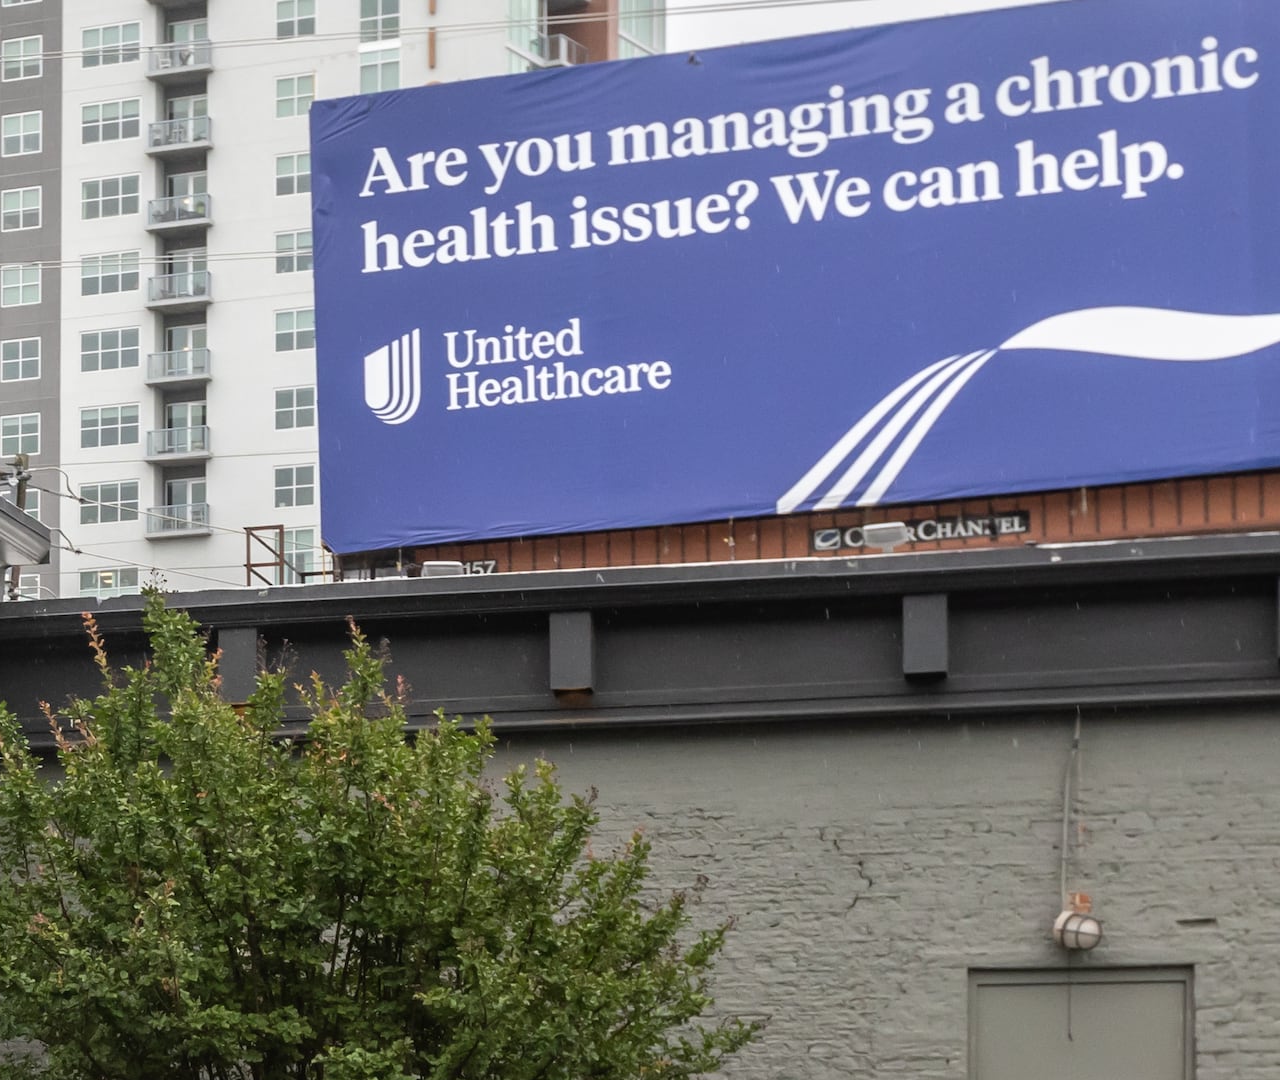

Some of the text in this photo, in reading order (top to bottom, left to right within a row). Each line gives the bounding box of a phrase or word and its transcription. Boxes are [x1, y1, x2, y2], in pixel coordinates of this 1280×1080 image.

[358, 36, 1259, 197] Are you managing a chronic
[360, 129, 1184, 273] health issue? We can help.
[443, 317, 584, 369] United
[445, 360, 672, 411] Healthcare
